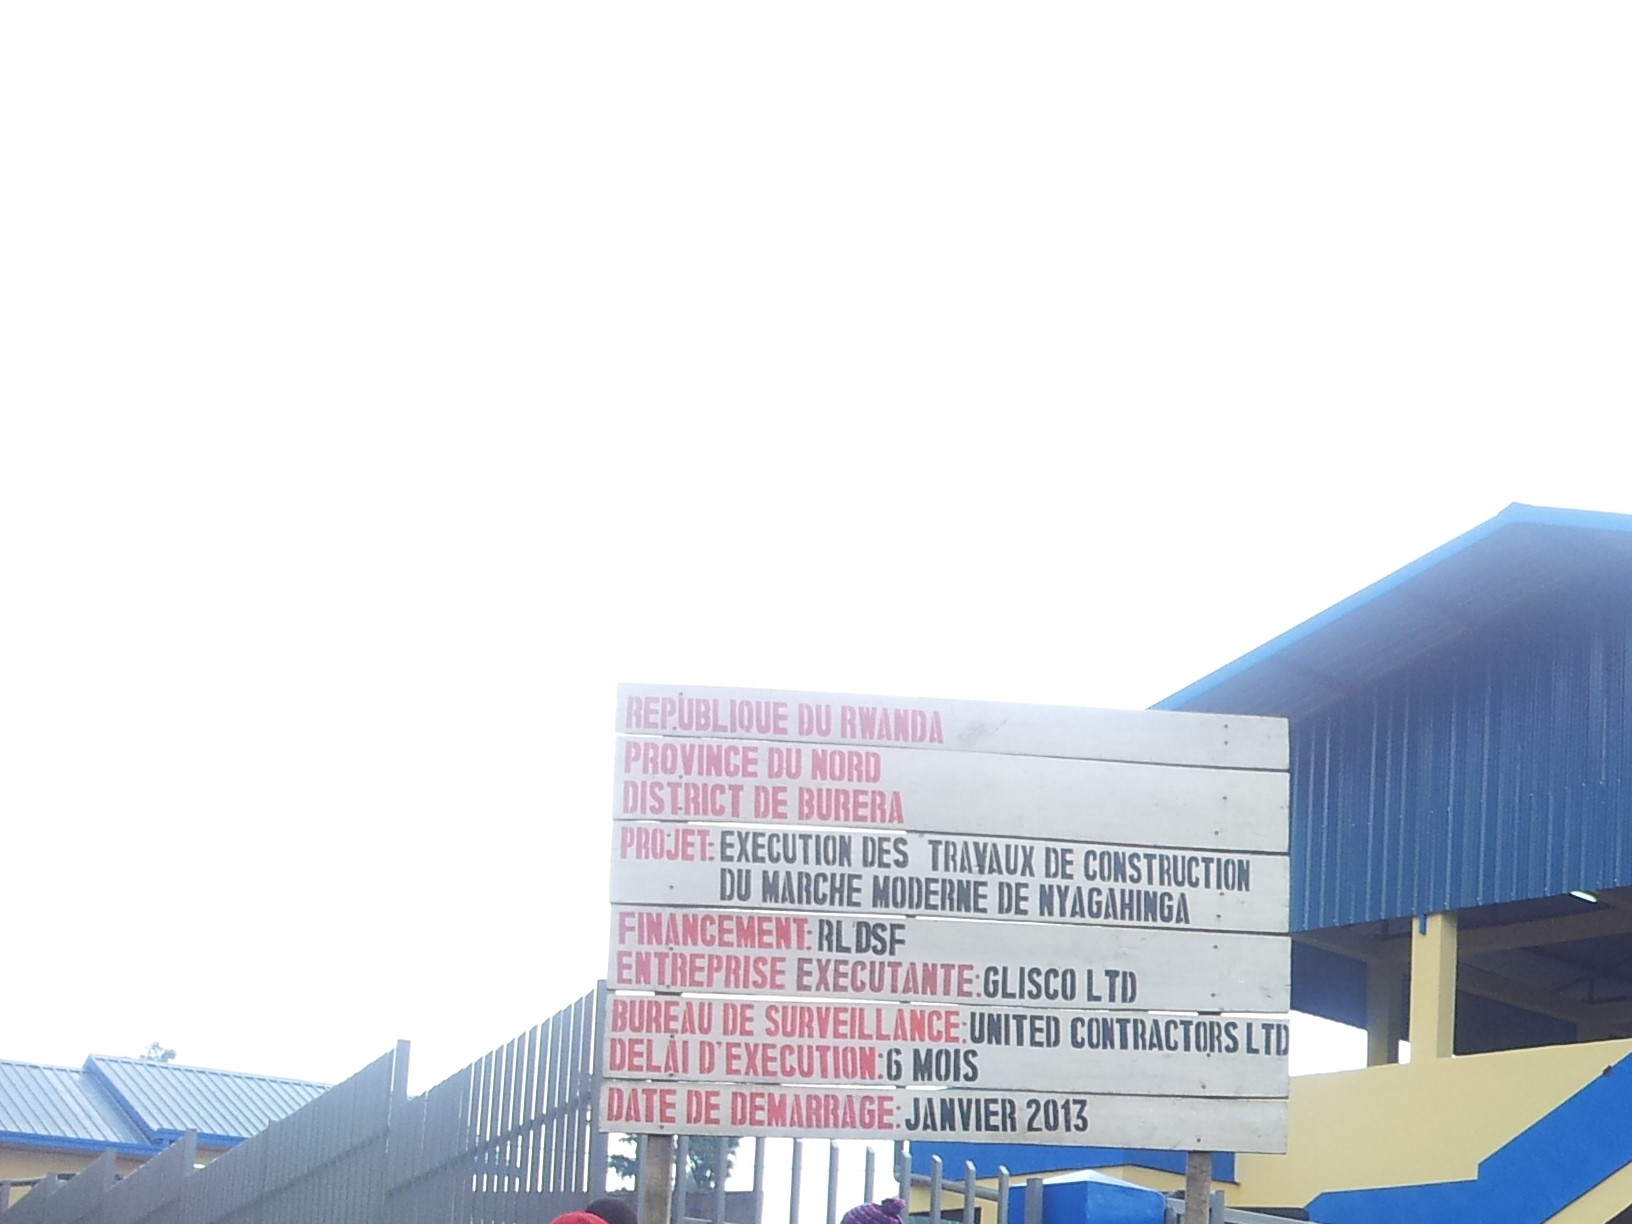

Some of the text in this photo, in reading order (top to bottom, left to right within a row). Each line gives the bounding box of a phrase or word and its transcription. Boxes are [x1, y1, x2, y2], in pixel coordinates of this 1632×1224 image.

[626, 696, 944, 744] REPUBLIQUE DU RWANDA
[624, 741, 881, 783] PROVINCE DU NORD
[622, 780, 904, 824] DISTRICT DE BURERA
[620, 827, 1250, 892] PROJET: EXECUTION DES TRAVAUX DE CONSTRUCTION
[720, 868, 1190, 924] DU MARCHE MODERNE DE NYAGAHINGA
[618, 912, 812, 950] FINANCEMENT:
[617, 951, 1137, 1003] ENTREPRISE EXECUTANTE: GLISCO LTD
[612, 999, 1289, 1056] BUREAU DE SURVEILLANCE: UNITED CONTRACTORS LTD
[609, 1038, 689, 1074] DELAI
[886, 1048, 903, 1081] 6
[912, 1048, 979, 1082] MOIS
[607, 1087, 1088, 1132] DATE DE DEMARRAGE: JANVIER 2013
